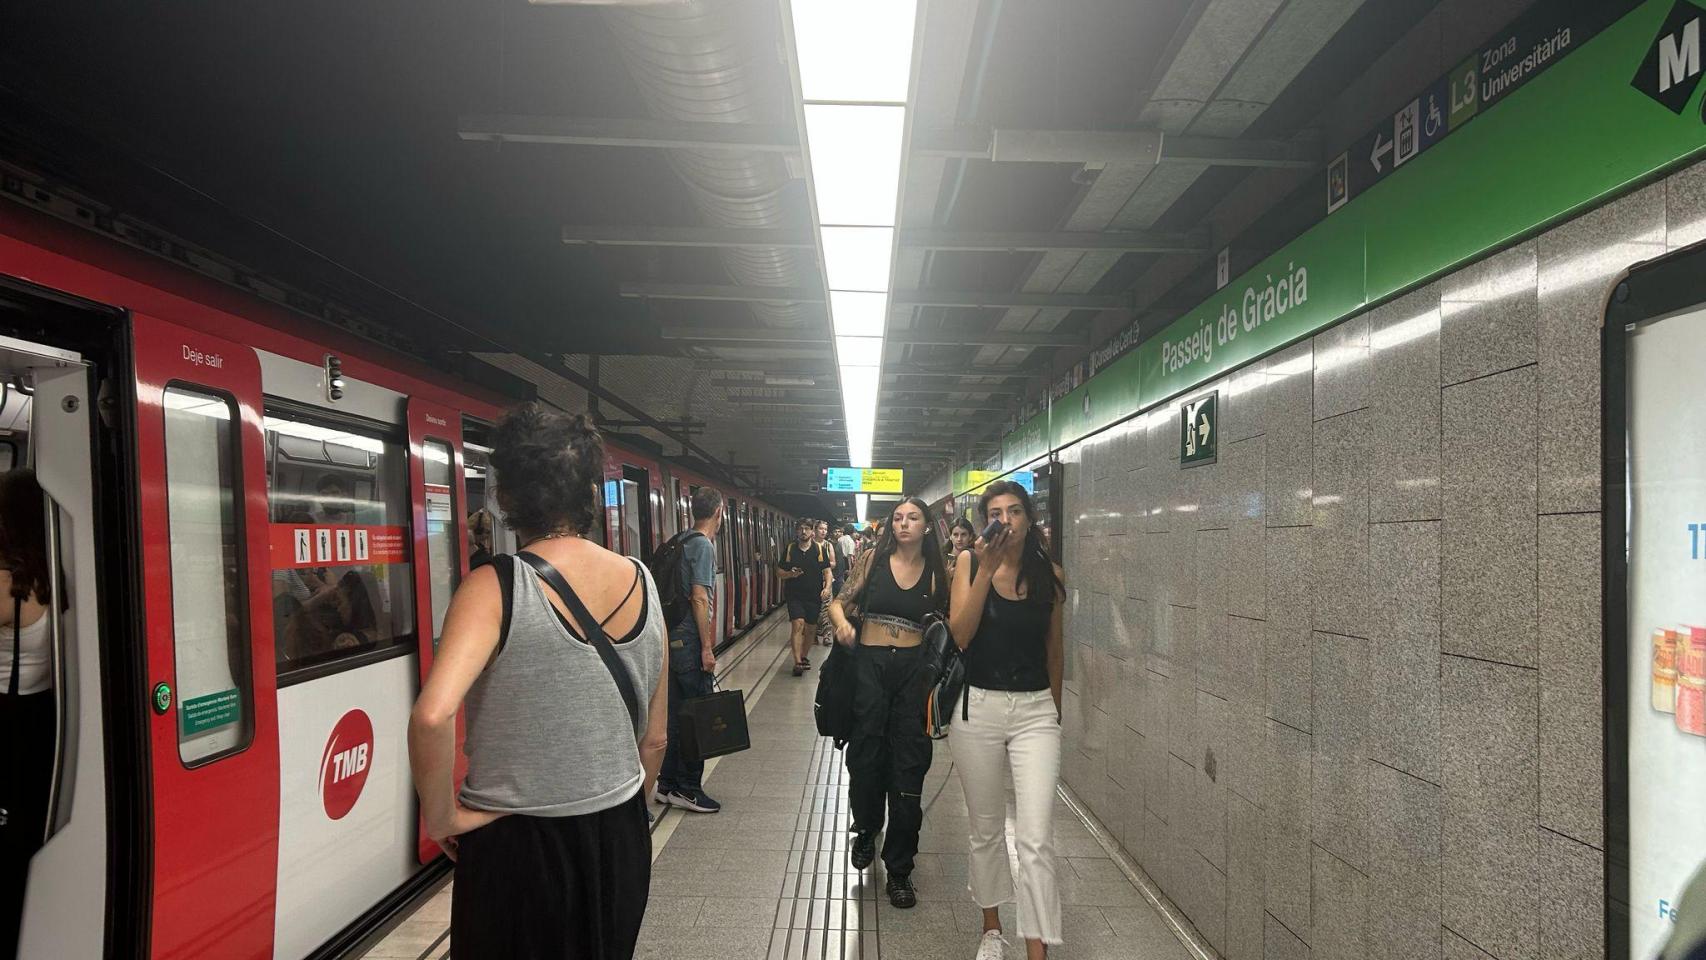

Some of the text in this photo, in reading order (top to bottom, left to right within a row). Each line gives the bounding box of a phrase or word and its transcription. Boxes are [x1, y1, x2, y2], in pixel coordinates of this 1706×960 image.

[1482, 36, 1517, 74] Zona
[1482, 27, 1571, 102] Universitària
[1658, 16, 1700, 93] M
[1451, 69, 1476, 115] L3
[1162, 261, 1308, 376] Passeig de Gràcia
[182, 344, 223, 369] Deje salir
[333, 742, 369, 784] TMB
